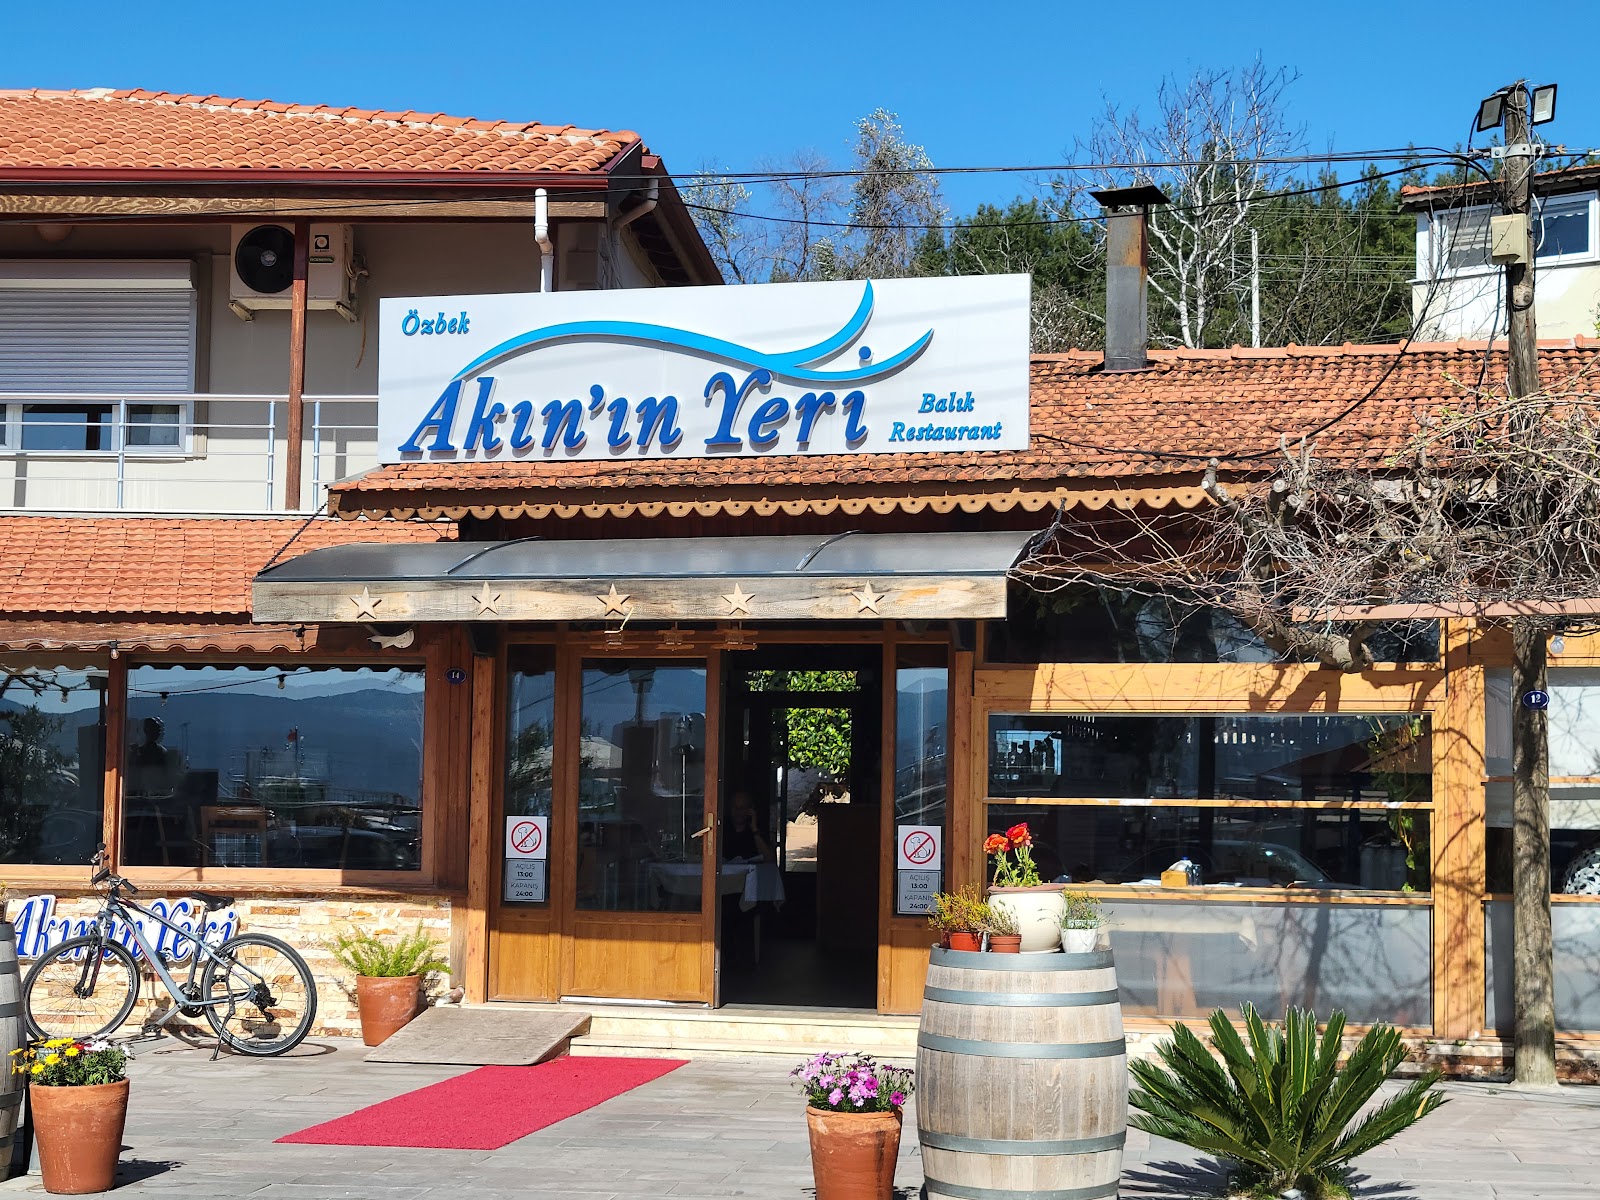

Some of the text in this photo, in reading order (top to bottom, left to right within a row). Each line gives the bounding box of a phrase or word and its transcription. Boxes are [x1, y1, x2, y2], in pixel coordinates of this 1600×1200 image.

[401, 309, 470, 336] Özbek
[703, 346, 868, 447] Yeri
[918, 391, 975, 414] Balık
[888, 421, 1002, 442] Restaurant
[451, 671, 460, 679] 14
[1531, 694, 1541, 704] 12
[510, 882, 539, 890] KAPANIŞ
[151, 901, 234, 959] Yeri
